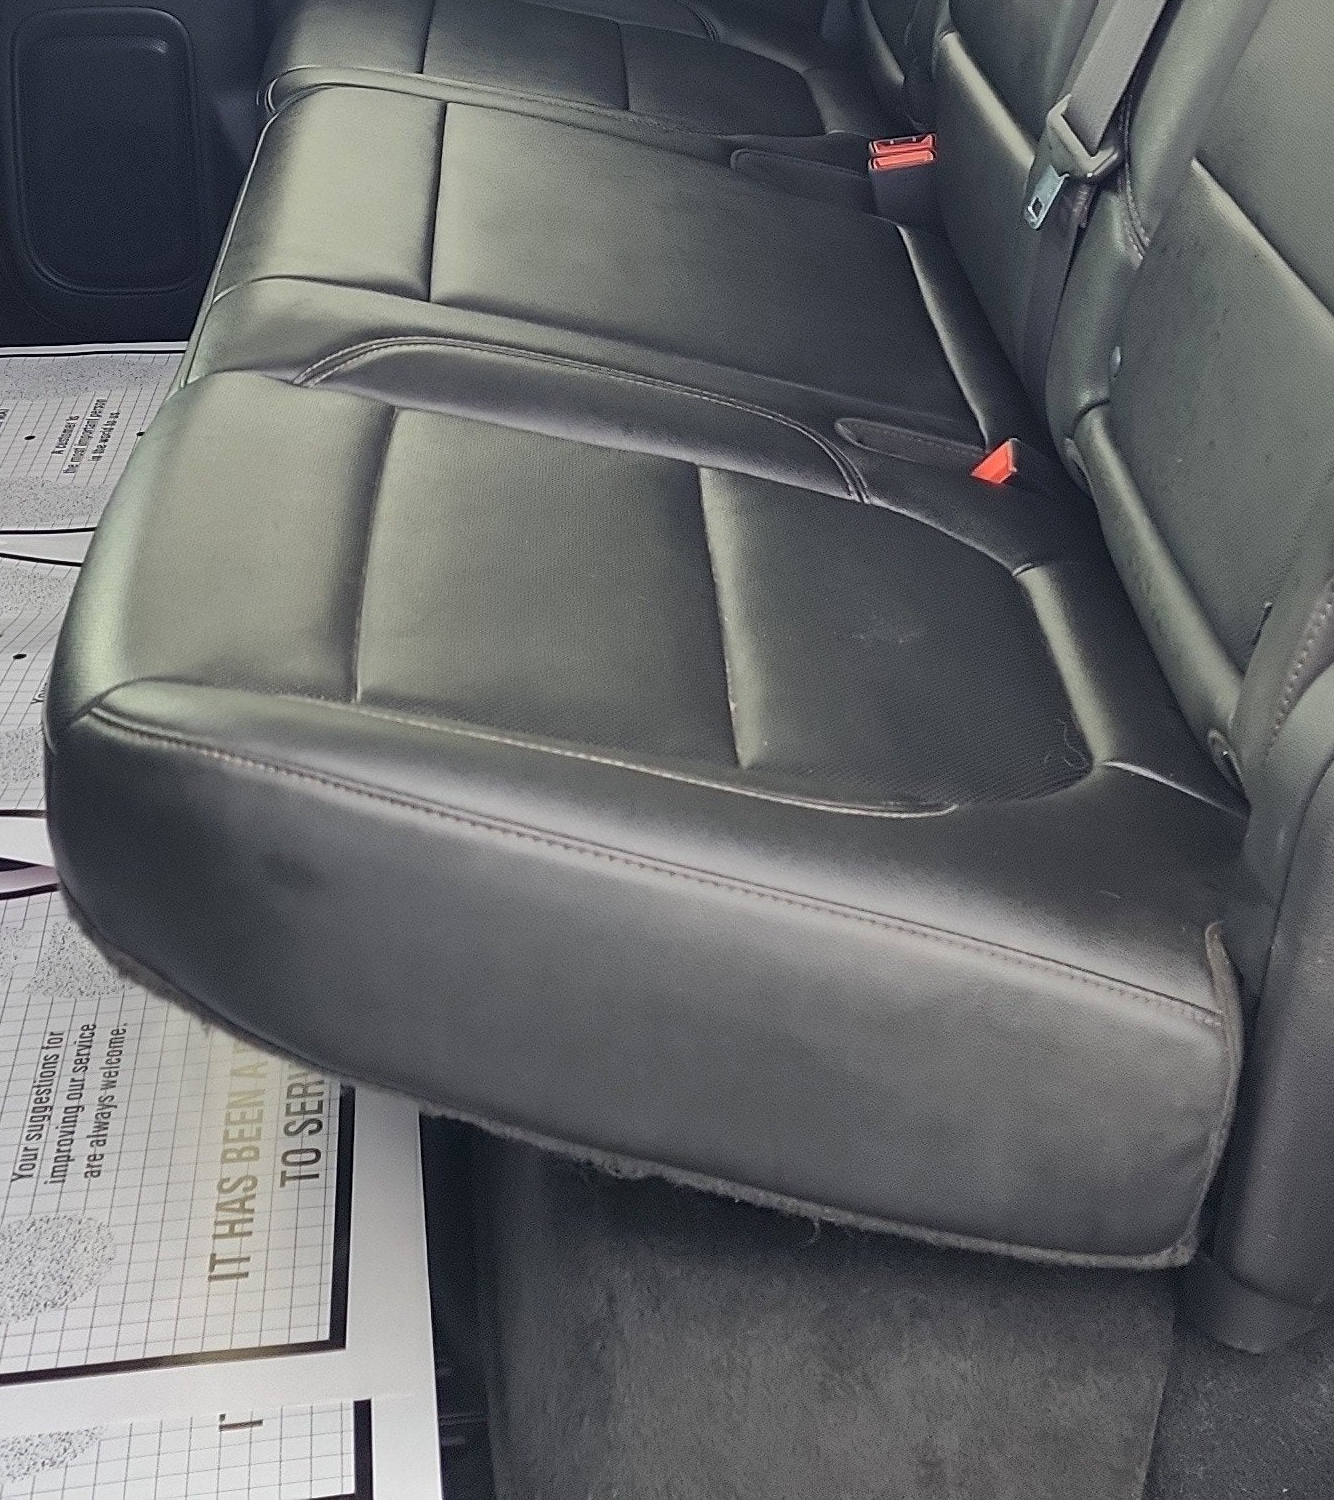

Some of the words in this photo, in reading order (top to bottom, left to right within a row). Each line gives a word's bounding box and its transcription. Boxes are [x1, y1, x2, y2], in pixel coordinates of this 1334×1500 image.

[41, 1031, 65, 1050] for
[72, 1023, 97, 1074] service
[99, 1022, 128, 1091] welcome.
[66, 1077, 86, 1101] our
[229, 1060, 268, 1079] A
[25, 1053, 60, 1142] suggestions
[86, 1095, 117, 1148] always
[221, 1089, 266, 1164] BEEN
[11, 1146, 39, 1183] Your
[43, 1105, 85, 1185] improving
[84, 1153, 104, 1179] are
[279, 1147, 322, 1188] TO
[212, 1174, 258, 1240] HAS
[208, 1252, 250, 1282] IT
